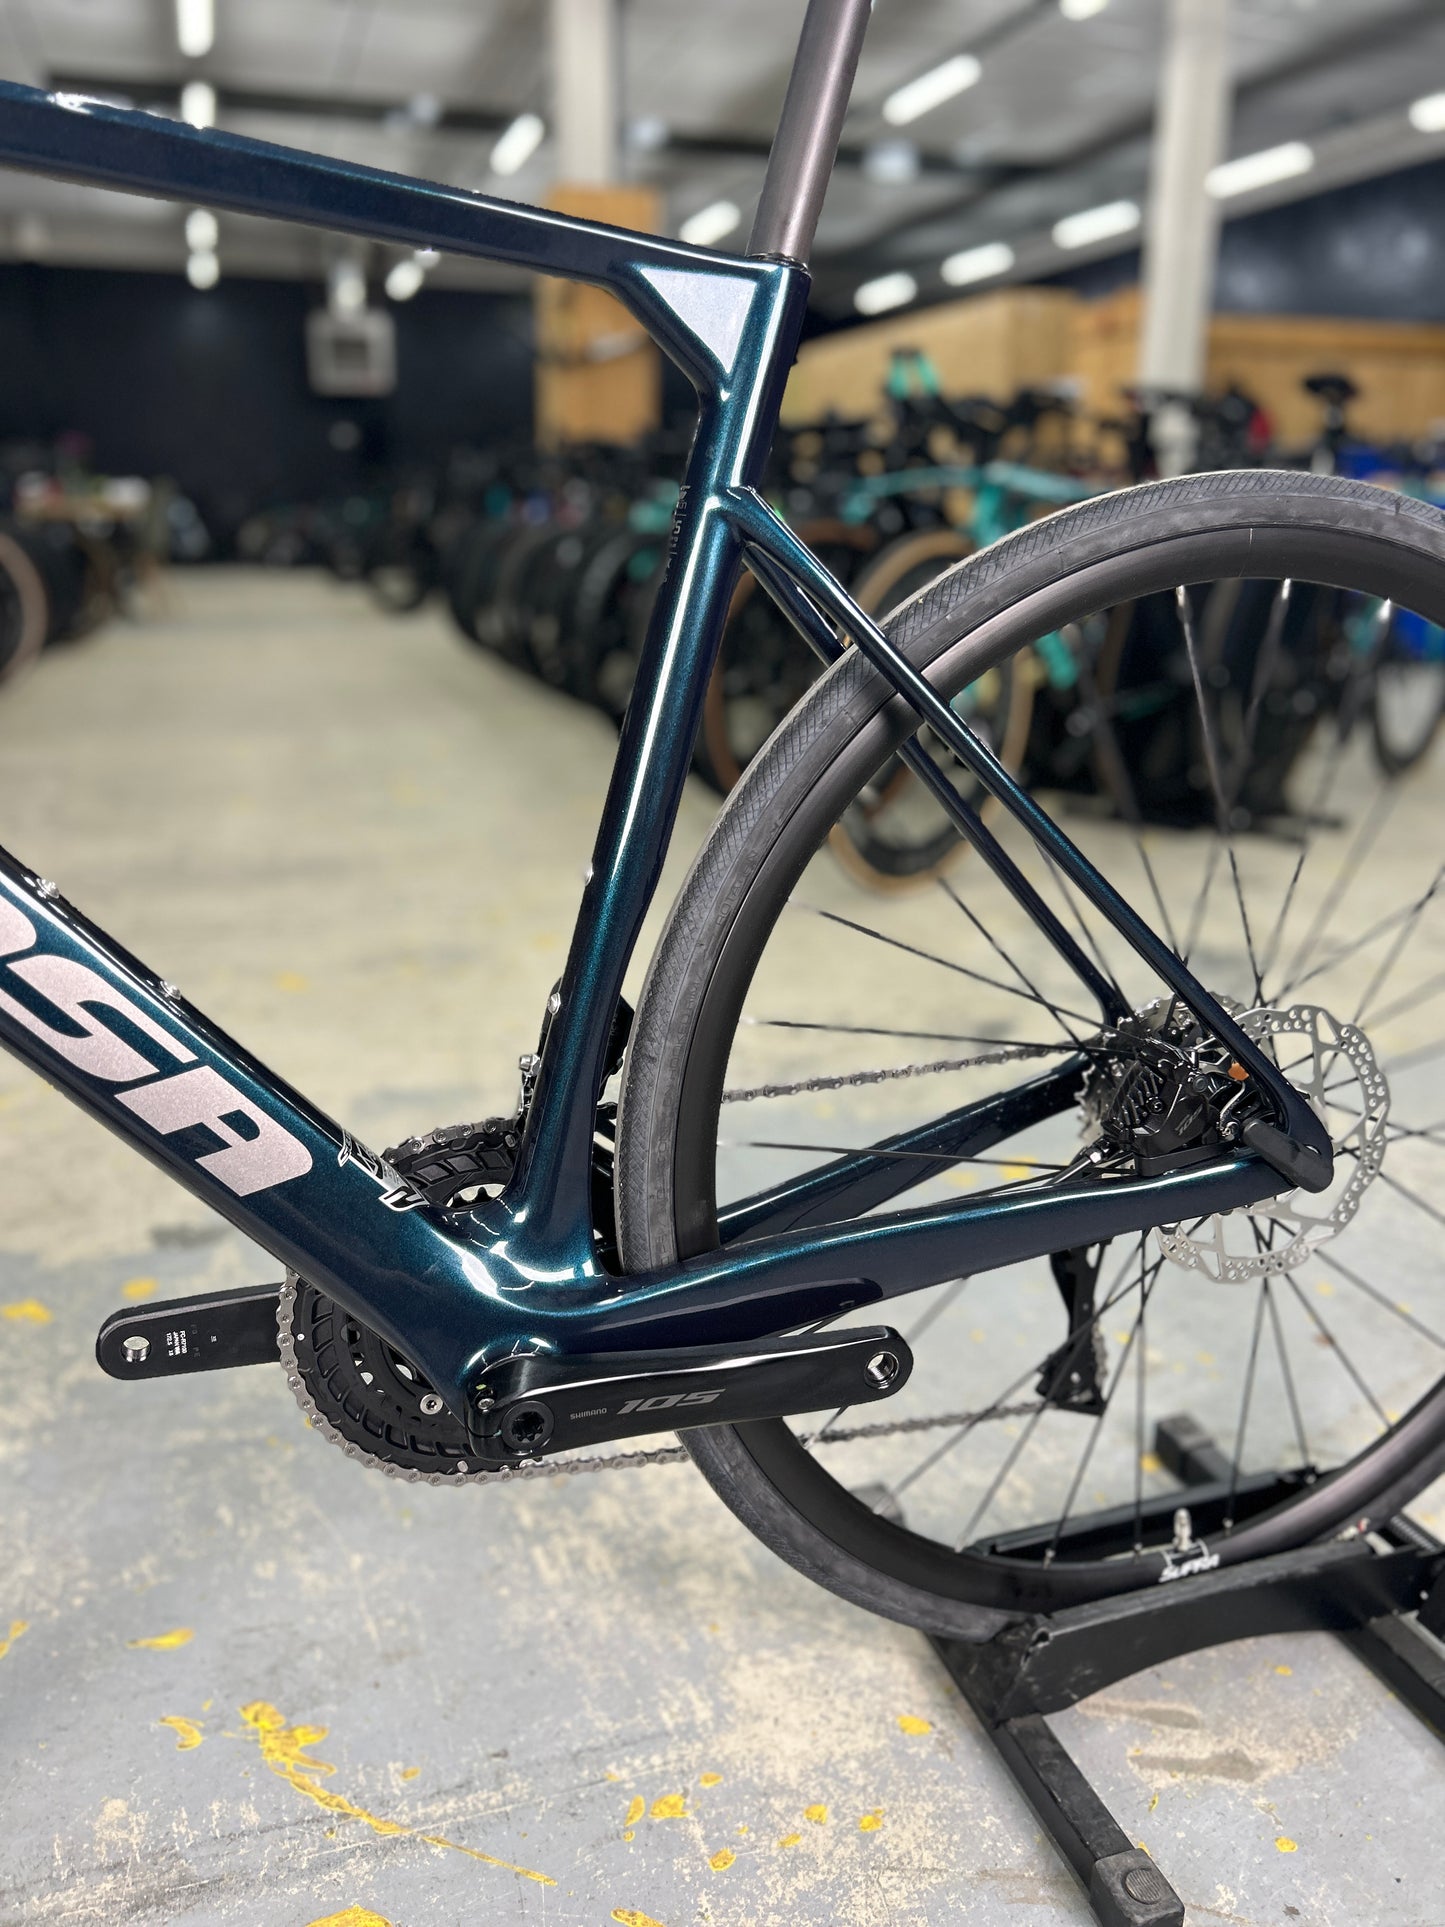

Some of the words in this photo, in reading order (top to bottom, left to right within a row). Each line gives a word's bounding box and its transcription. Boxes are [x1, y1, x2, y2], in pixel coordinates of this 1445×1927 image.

[0, 895, 313, 1197] SA
[570, 1408, 608, 1420] SHIMANO
[616, 1388, 727, 1415] 105
